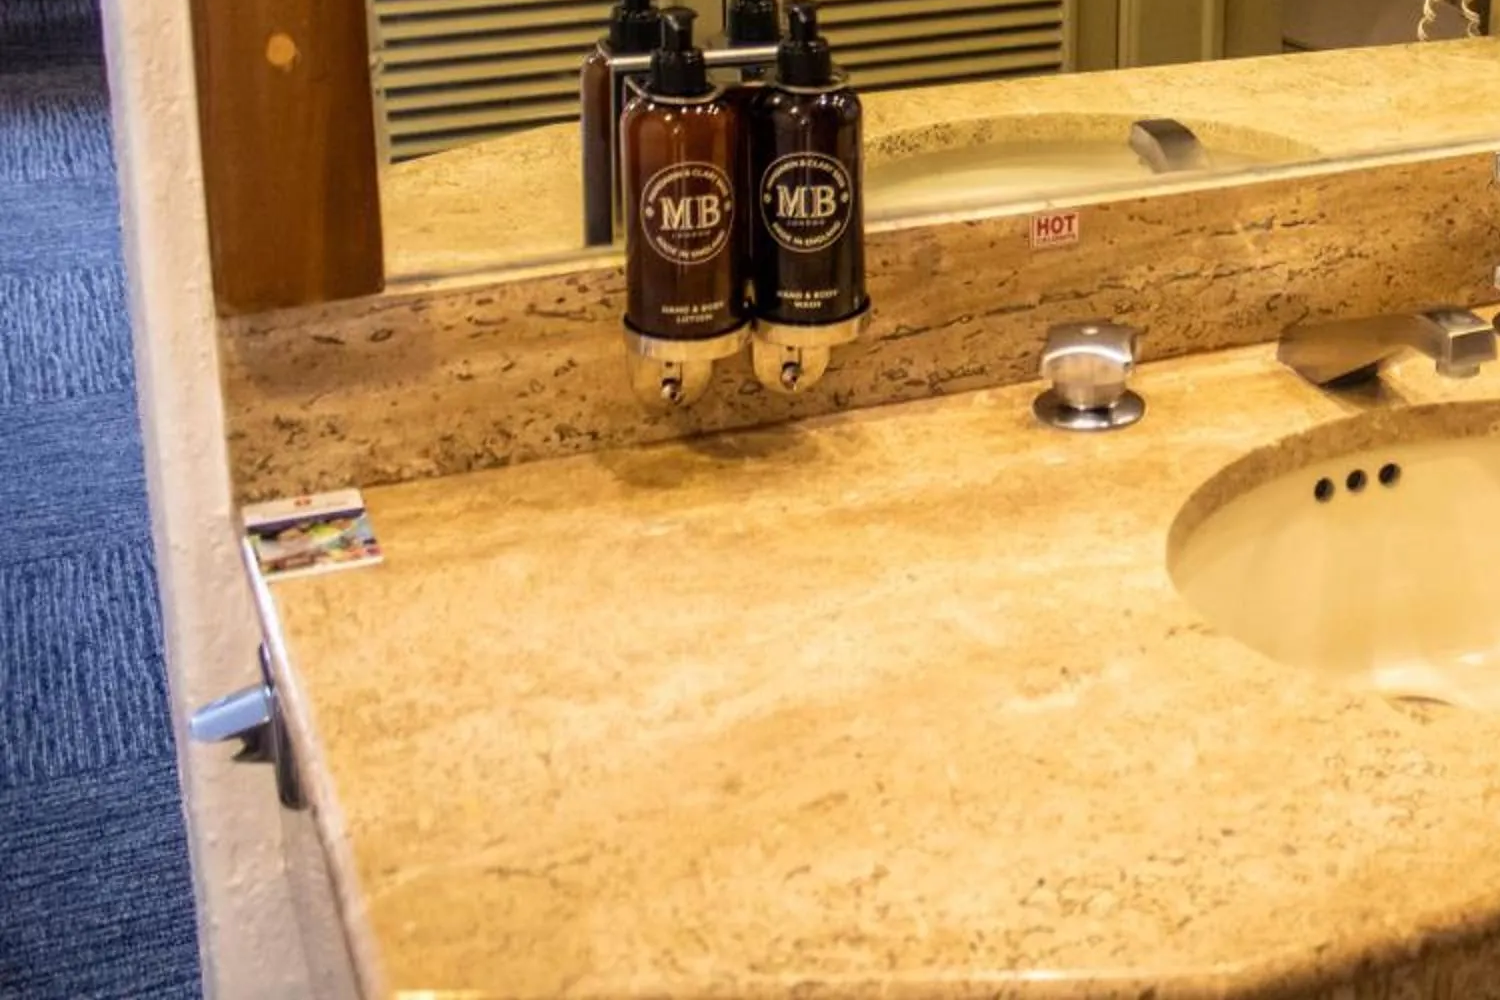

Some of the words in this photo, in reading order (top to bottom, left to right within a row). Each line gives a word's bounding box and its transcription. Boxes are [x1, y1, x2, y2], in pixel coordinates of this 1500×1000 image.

[660, 195, 721, 231] MB
[775, 184, 837, 219] MB
[1037, 214, 1076, 237] HOT
